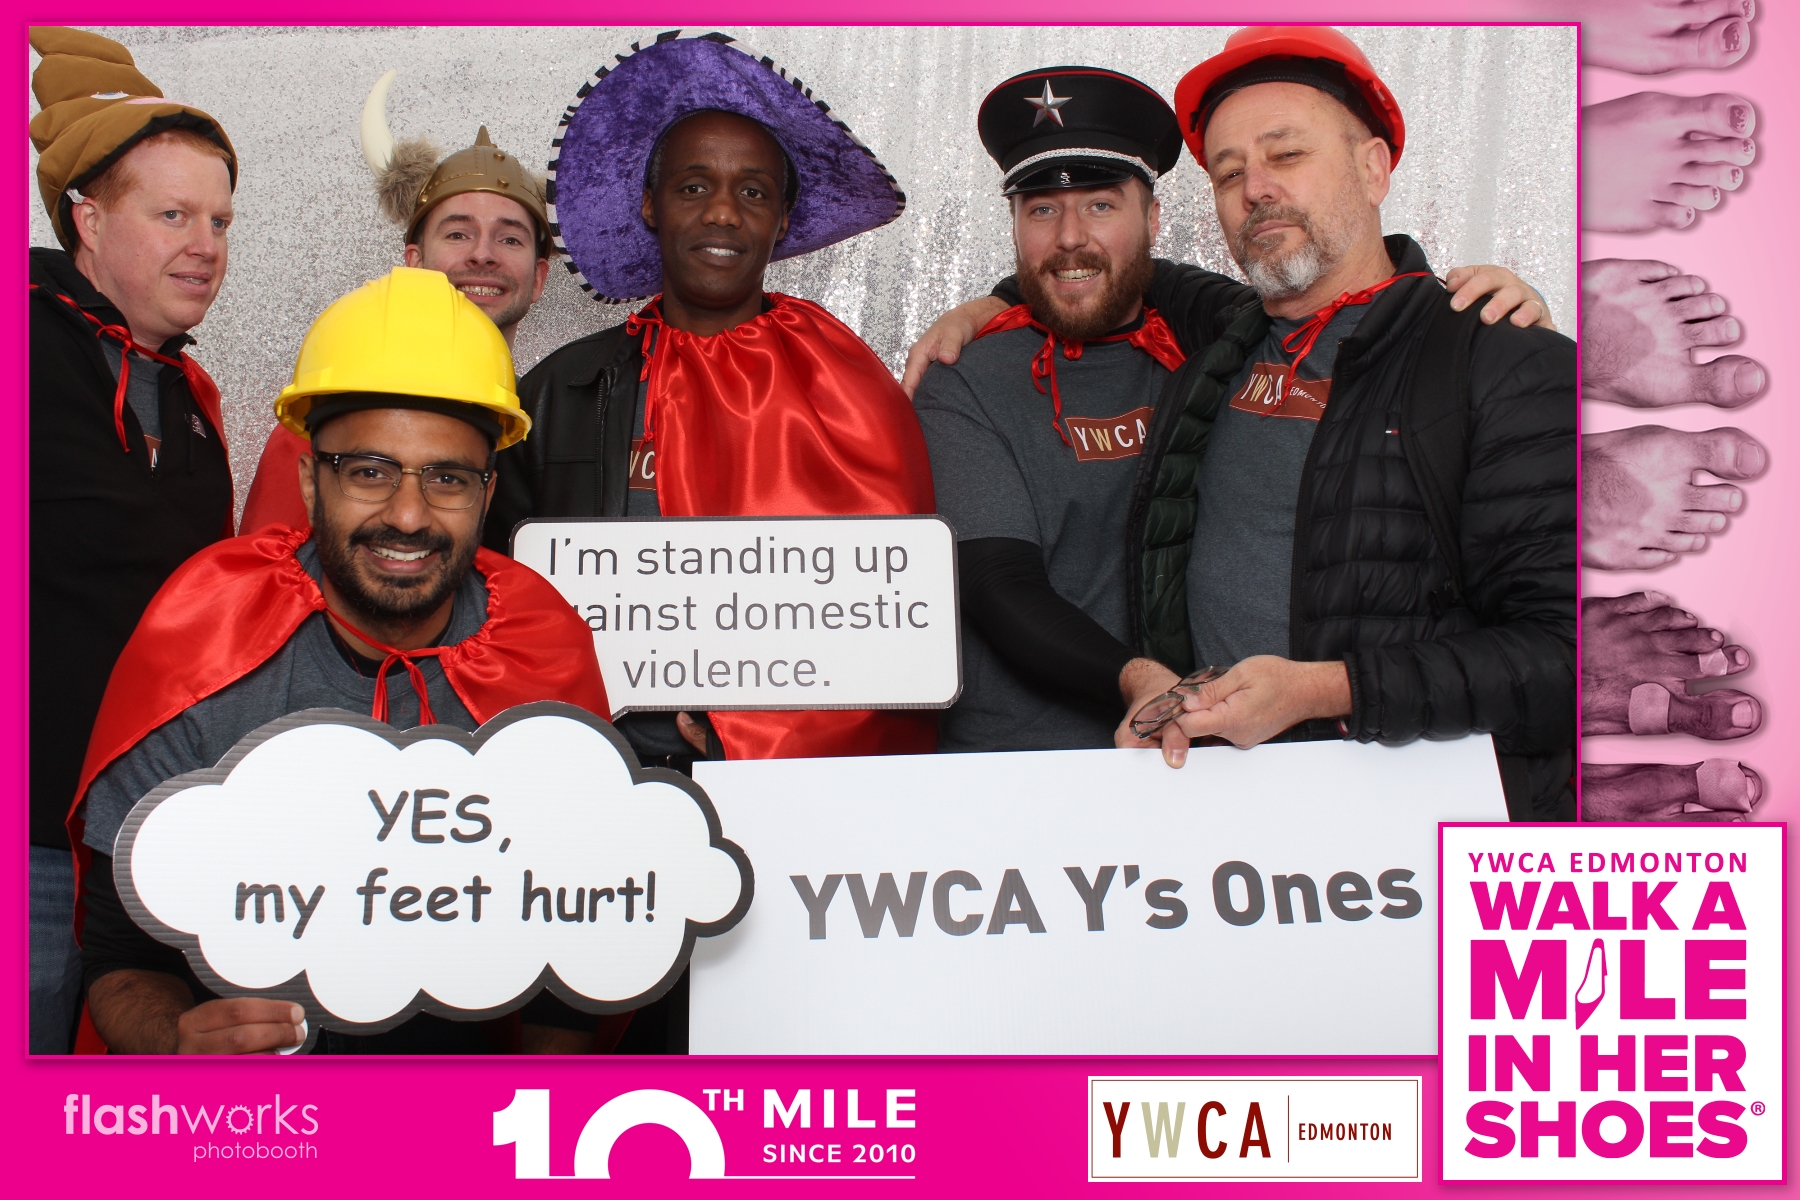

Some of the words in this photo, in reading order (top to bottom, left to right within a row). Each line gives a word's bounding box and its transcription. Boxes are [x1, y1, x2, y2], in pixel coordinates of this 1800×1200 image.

[549, 537, 618, 576] I'm
[636, 536, 835, 585] standing
[855, 545, 908, 584] up
[573, 593, 697, 632] ainst
[715, 590, 929, 631] domestic
[622, 648, 831, 689] violence.
[368, 788, 511, 853] YES,
[235, 882, 326, 940] my
[356, 867, 492, 926] feet
[521, 869, 656, 923] hurt!
[789, 868, 1047, 940] YWCA
[1063, 864, 1189, 932] Y's
[1211, 860, 1423, 927] Ones
